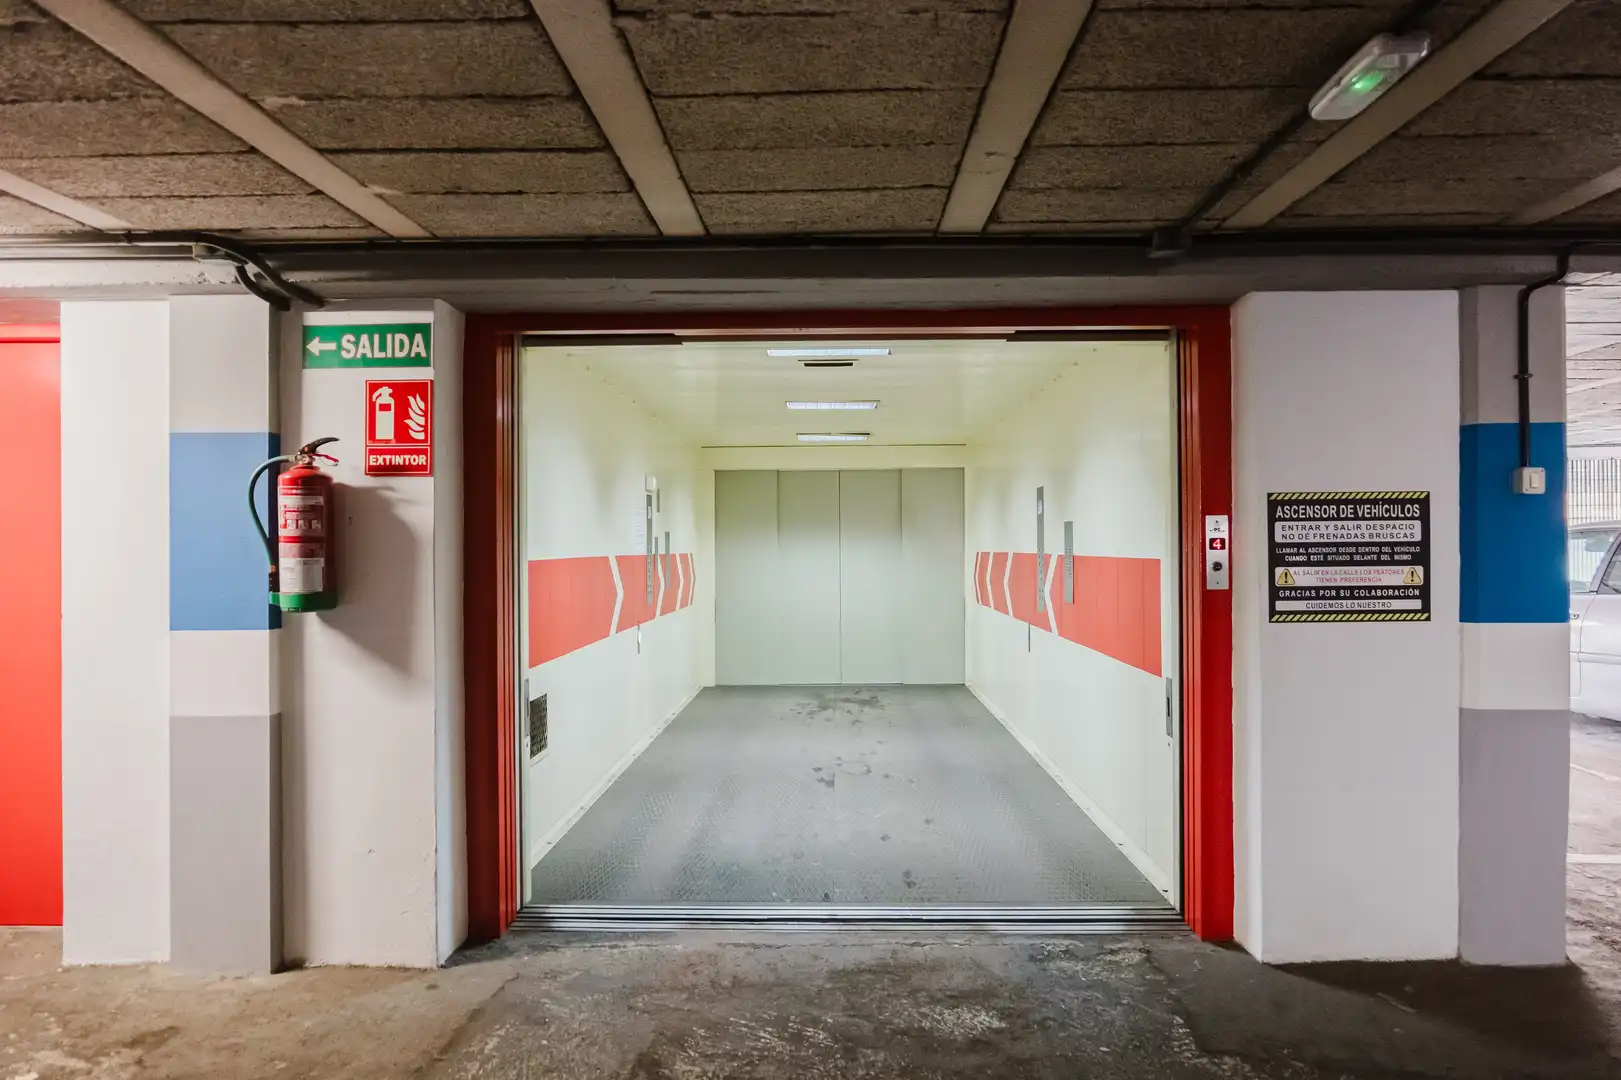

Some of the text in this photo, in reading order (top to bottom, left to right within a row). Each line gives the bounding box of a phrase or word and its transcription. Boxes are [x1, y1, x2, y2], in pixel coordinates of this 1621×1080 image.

[340, 333, 428, 359] SALIDA
[369, 454, 427, 466] EXTINTOR
[1276, 501, 1420, 518] ASCENSOR DE VEHÍCULOS
[1212, 538, 1222, 550] 4
[1354, 588, 1420, 596] COLABORACIÓN
